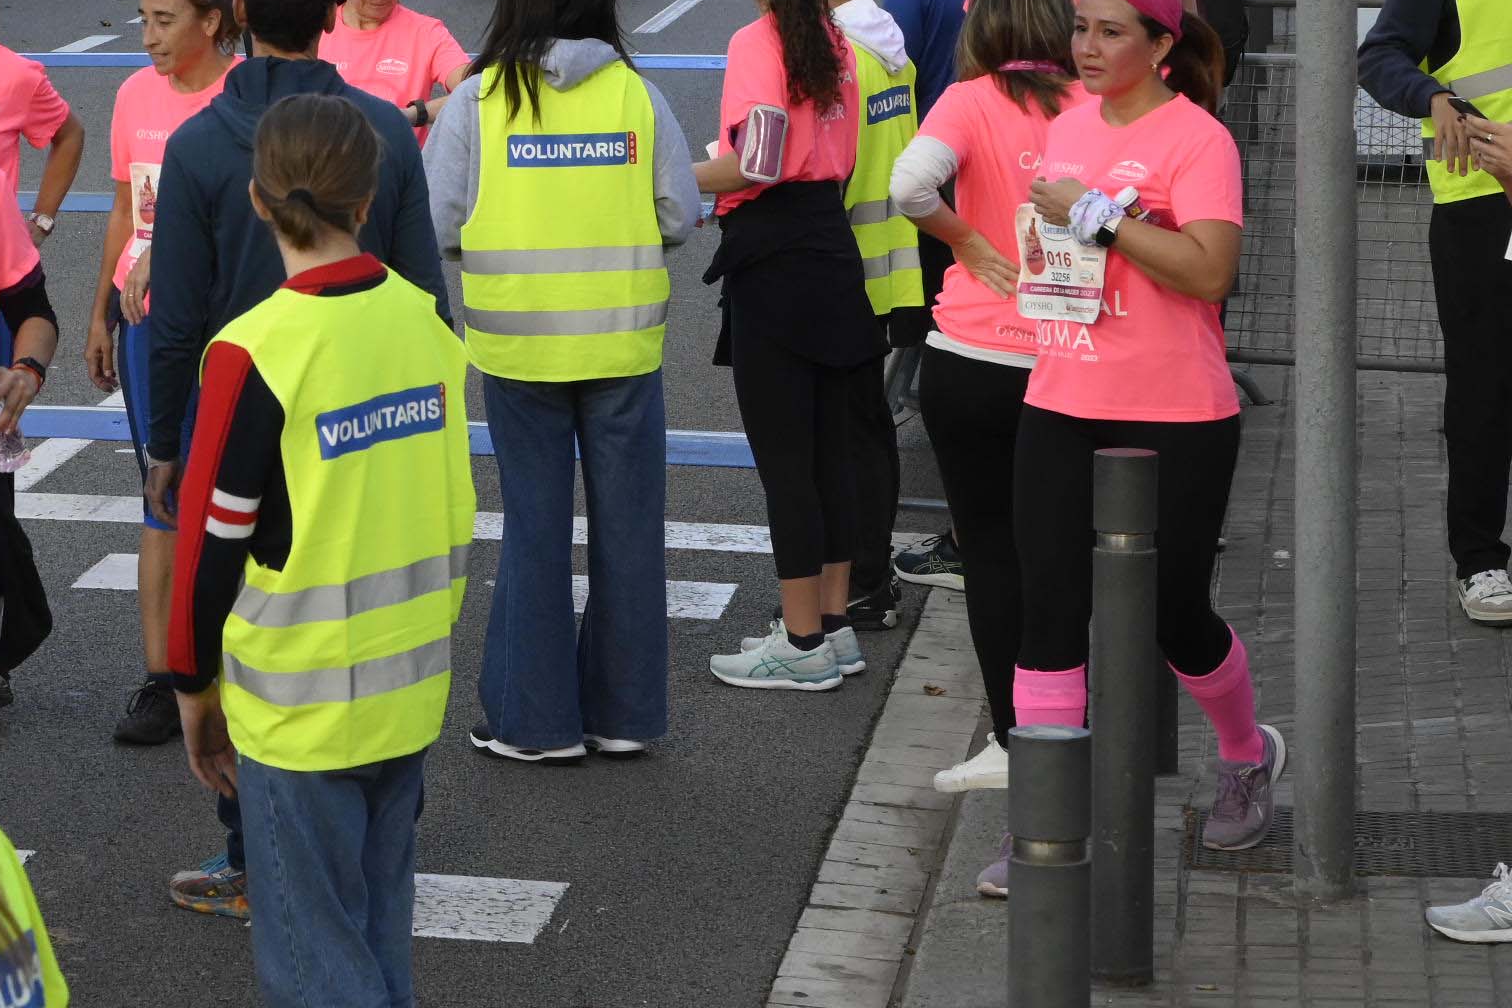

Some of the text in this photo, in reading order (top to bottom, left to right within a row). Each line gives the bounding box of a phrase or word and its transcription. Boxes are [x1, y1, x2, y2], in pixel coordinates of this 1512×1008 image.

[510, 141, 625, 160] VOLUNTARIS
[1046, 250, 1072, 268] 016
[1051, 271, 1071, 282] 32256
[1025, 301, 1053, 311] OYSHO
[321, 397, 441, 447] VOLUNTARIS
